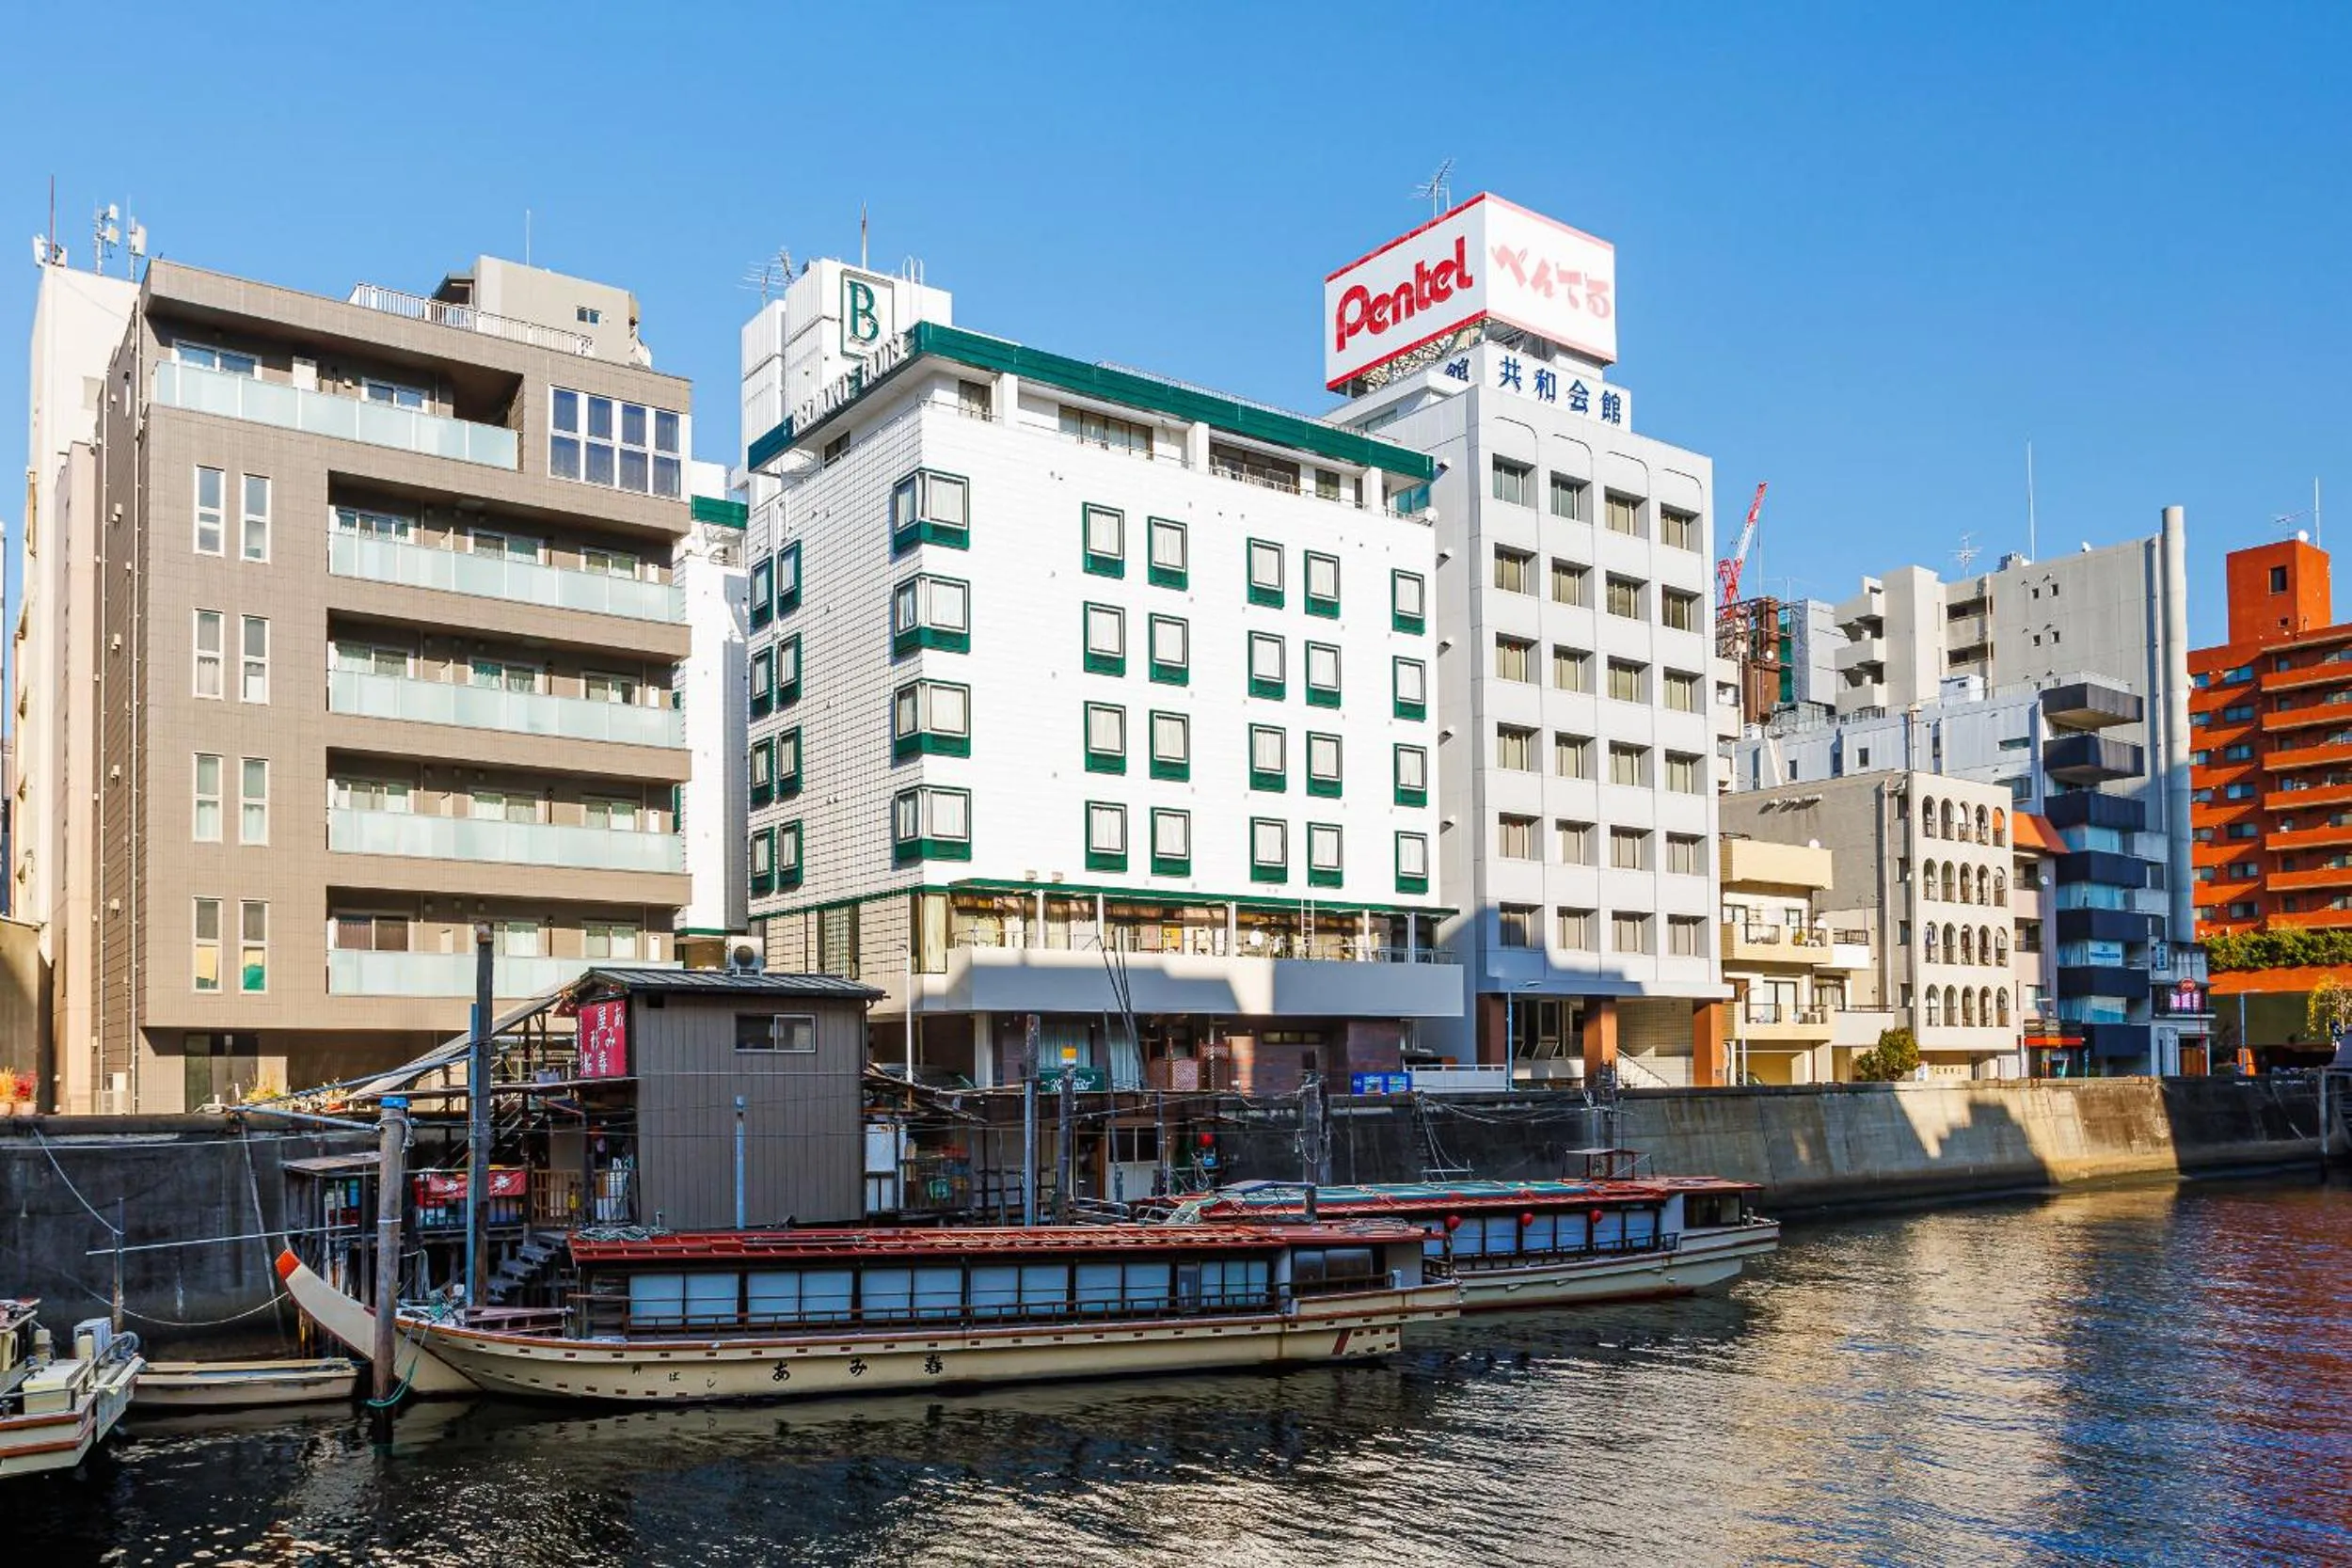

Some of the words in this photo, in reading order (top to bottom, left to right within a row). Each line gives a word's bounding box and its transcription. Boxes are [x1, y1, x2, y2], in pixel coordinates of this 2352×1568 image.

[846, 279, 880, 341] B
[1336, 236, 1473, 353] Pentel
[1491, 243, 1612, 319] ぺんてる
[1499, 355, 1622, 426] 共和会館
[772, 1354, 944, 1382] あみ春
